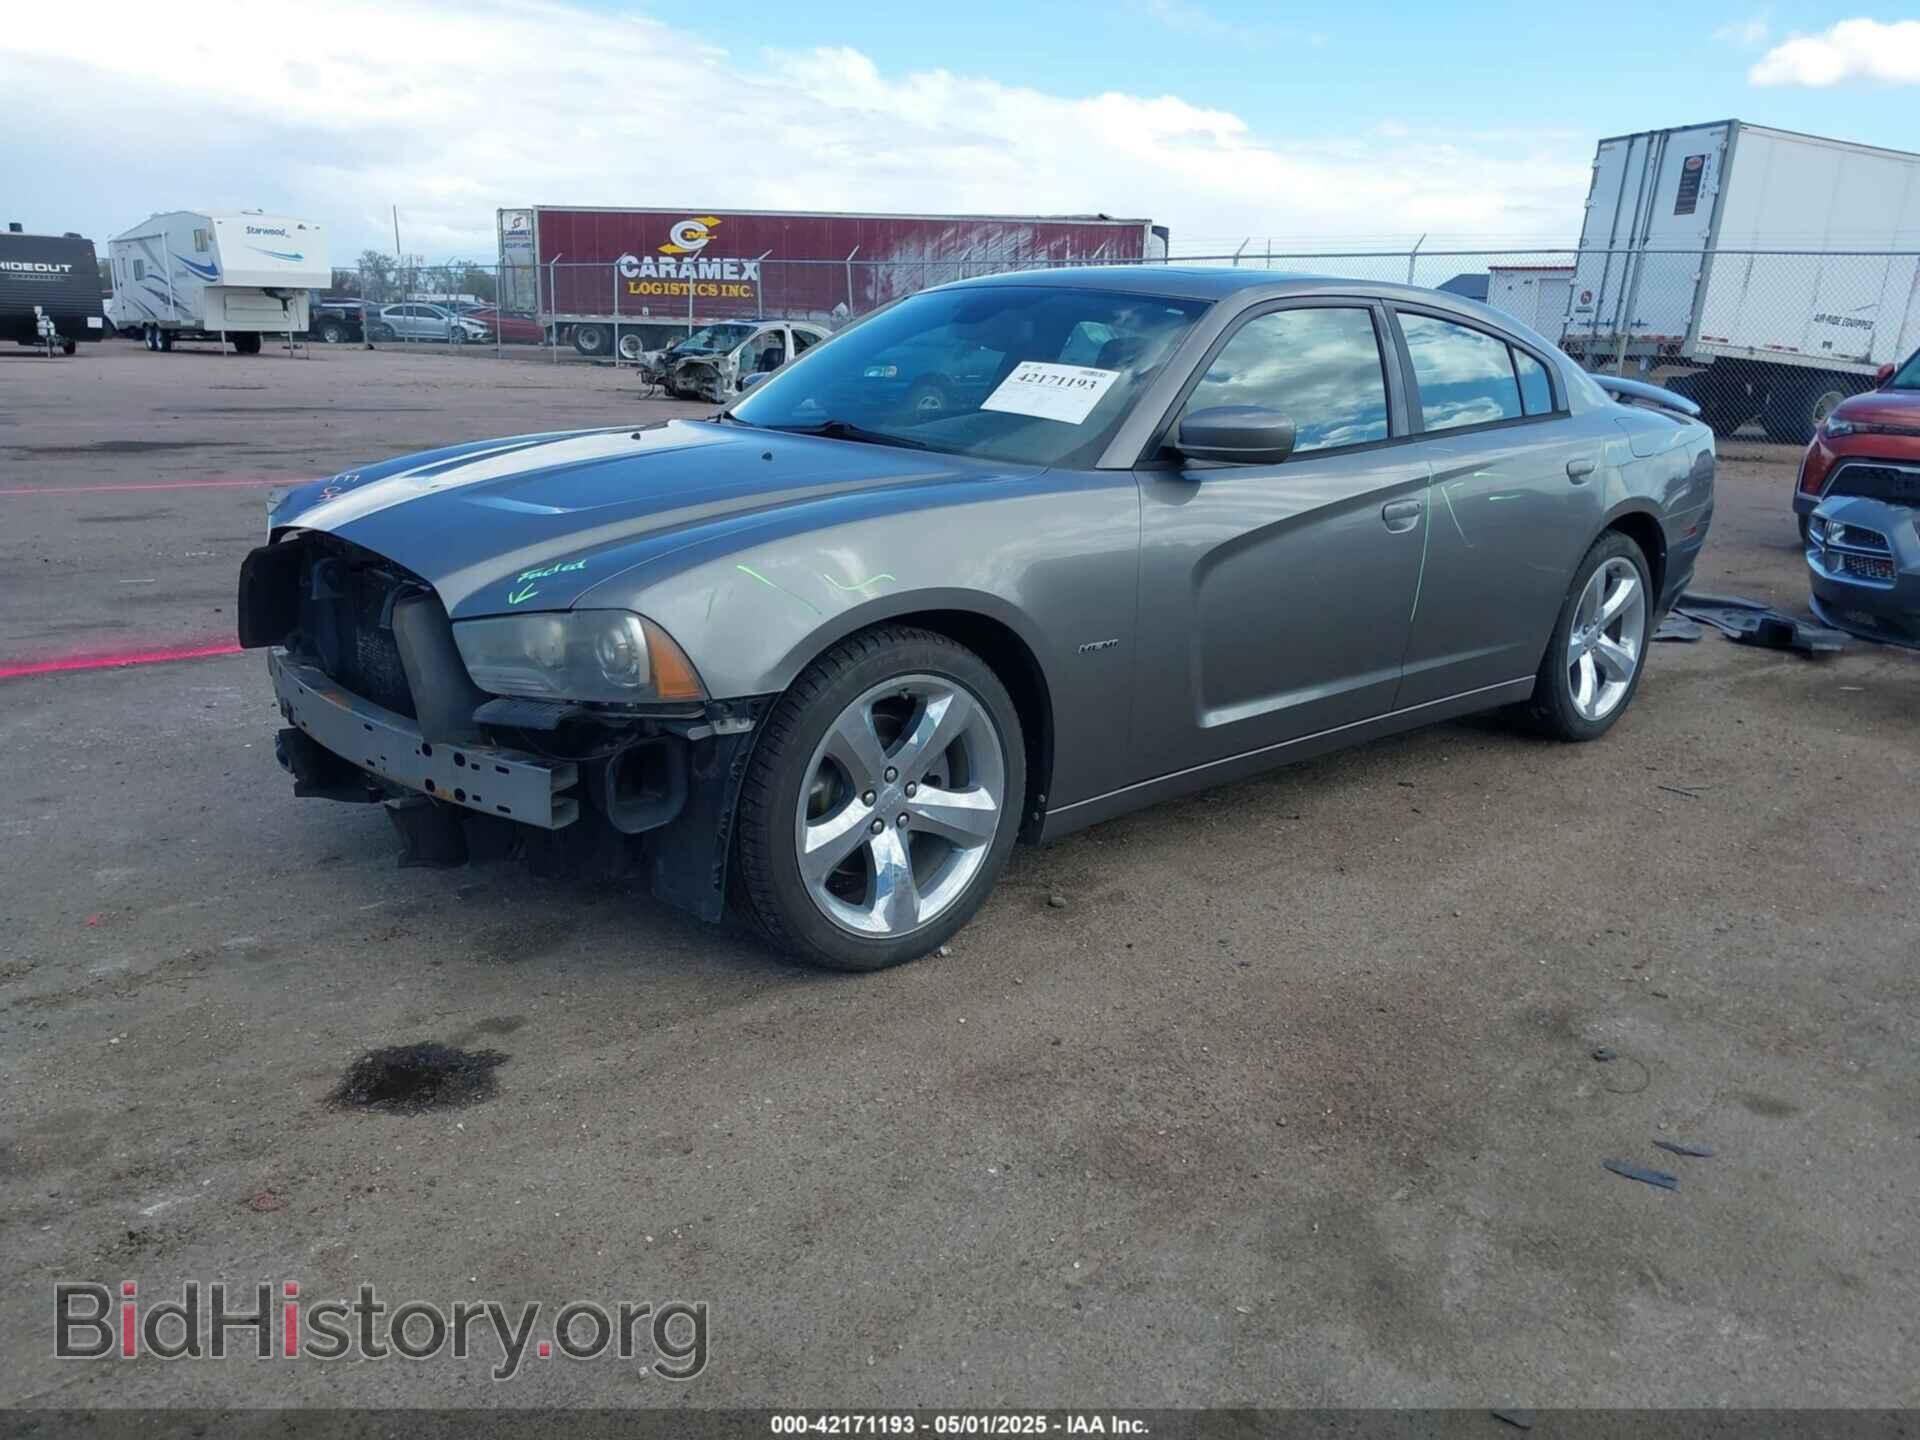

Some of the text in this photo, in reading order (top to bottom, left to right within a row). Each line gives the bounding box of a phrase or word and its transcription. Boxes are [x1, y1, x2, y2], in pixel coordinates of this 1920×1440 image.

[246, 226, 286, 236] Starwood
[0, 262, 72, 272] HIDEOUT
[619, 255, 760, 281] CARAMEX
[721, 284, 754, 297] INC.
[1018, 372, 1097, 391] 42171193
